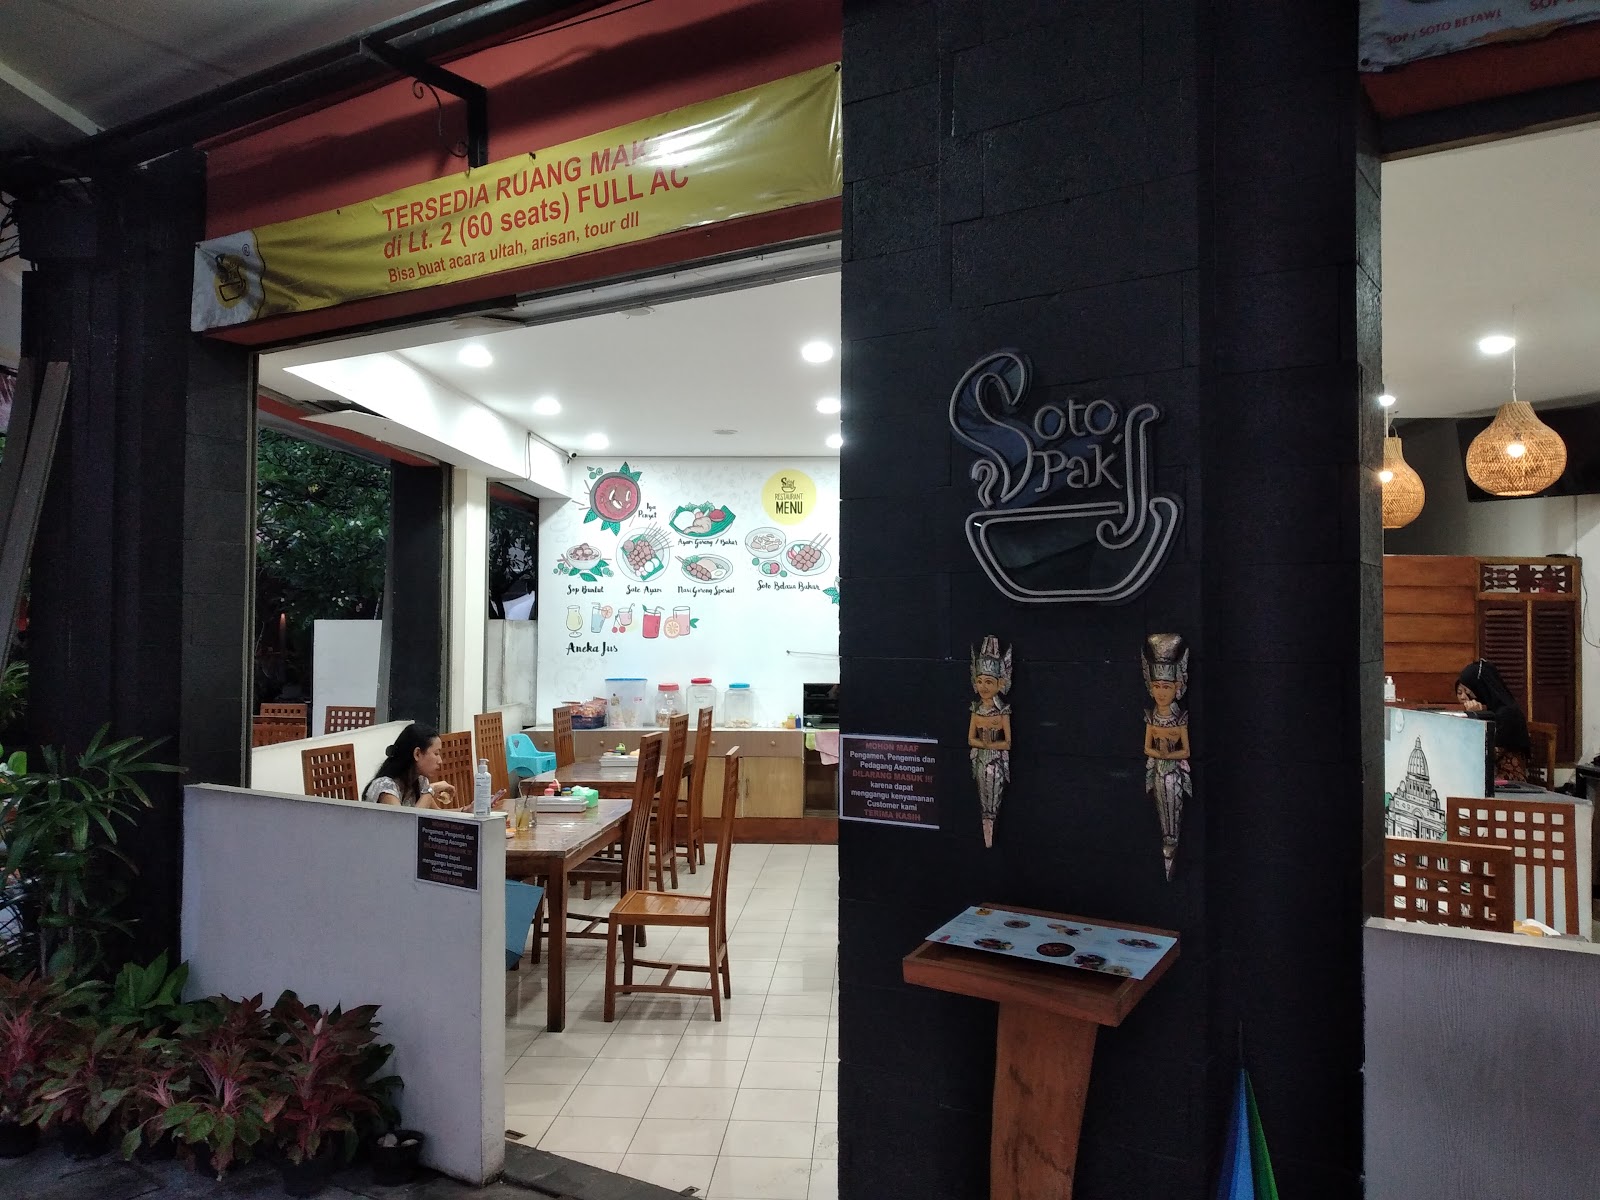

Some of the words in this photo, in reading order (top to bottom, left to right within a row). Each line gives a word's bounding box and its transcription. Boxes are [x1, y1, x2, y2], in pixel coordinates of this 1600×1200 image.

[1419, 21, 1451, 38] SOTO
[382, 187, 489, 231] TERSEDIA
[496, 157, 581, 201] RUANG
[384, 234, 401, 259] di
[408, 229, 433, 253] Lt.
[441, 222, 452, 245] 2
[459, 212, 492, 247] (60
[501, 192, 569, 232] seats)
[577, 174, 643, 213] FULL
[650, 165, 689, 195] AC
[388, 267, 415, 283] Bisa
[417, 257, 446, 276] buat
[449, 252, 485, 269] acara
[490, 240, 527, 261] ultah,
[532, 229, 579, 250] arisan,
[585, 219, 616, 238] tour
[620, 211, 639, 229] dll
[949, 352, 1119, 504] Soto
[775, 501, 803, 514] MENU
[566, 584, 579, 595] Sop
[757, 579, 771, 591] Soto
[566, 641, 599, 655] Aneka
[600, 641, 618, 656] Jus
[865, 742, 895, 751] MOHON
[896, 744, 920, 752] MAAF
[849, 750, 886, 761] Pengamen,
[887, 753, 920, 763] Pengemis
[922, 755, 936, 763] dan
[860, 761, 892, 772] Pedagang
[894, 763, 925, 773] Asongan
[852, 769, 892, 780] DILARANG
[893, 773, 923, 782] MASUK
[870, 781, 892, 789] karena
[894, 783, 914, 792] dapat
[851, 790, 889, 800] menggangu
[891, 793, 934, 803] kenyamanan
[867, 800, 900, 809] Customer
[900, 801, 917, 811] kami
[864, 809, 894, 818] TERIMA
[895, 811, 920, 821] KASIH
